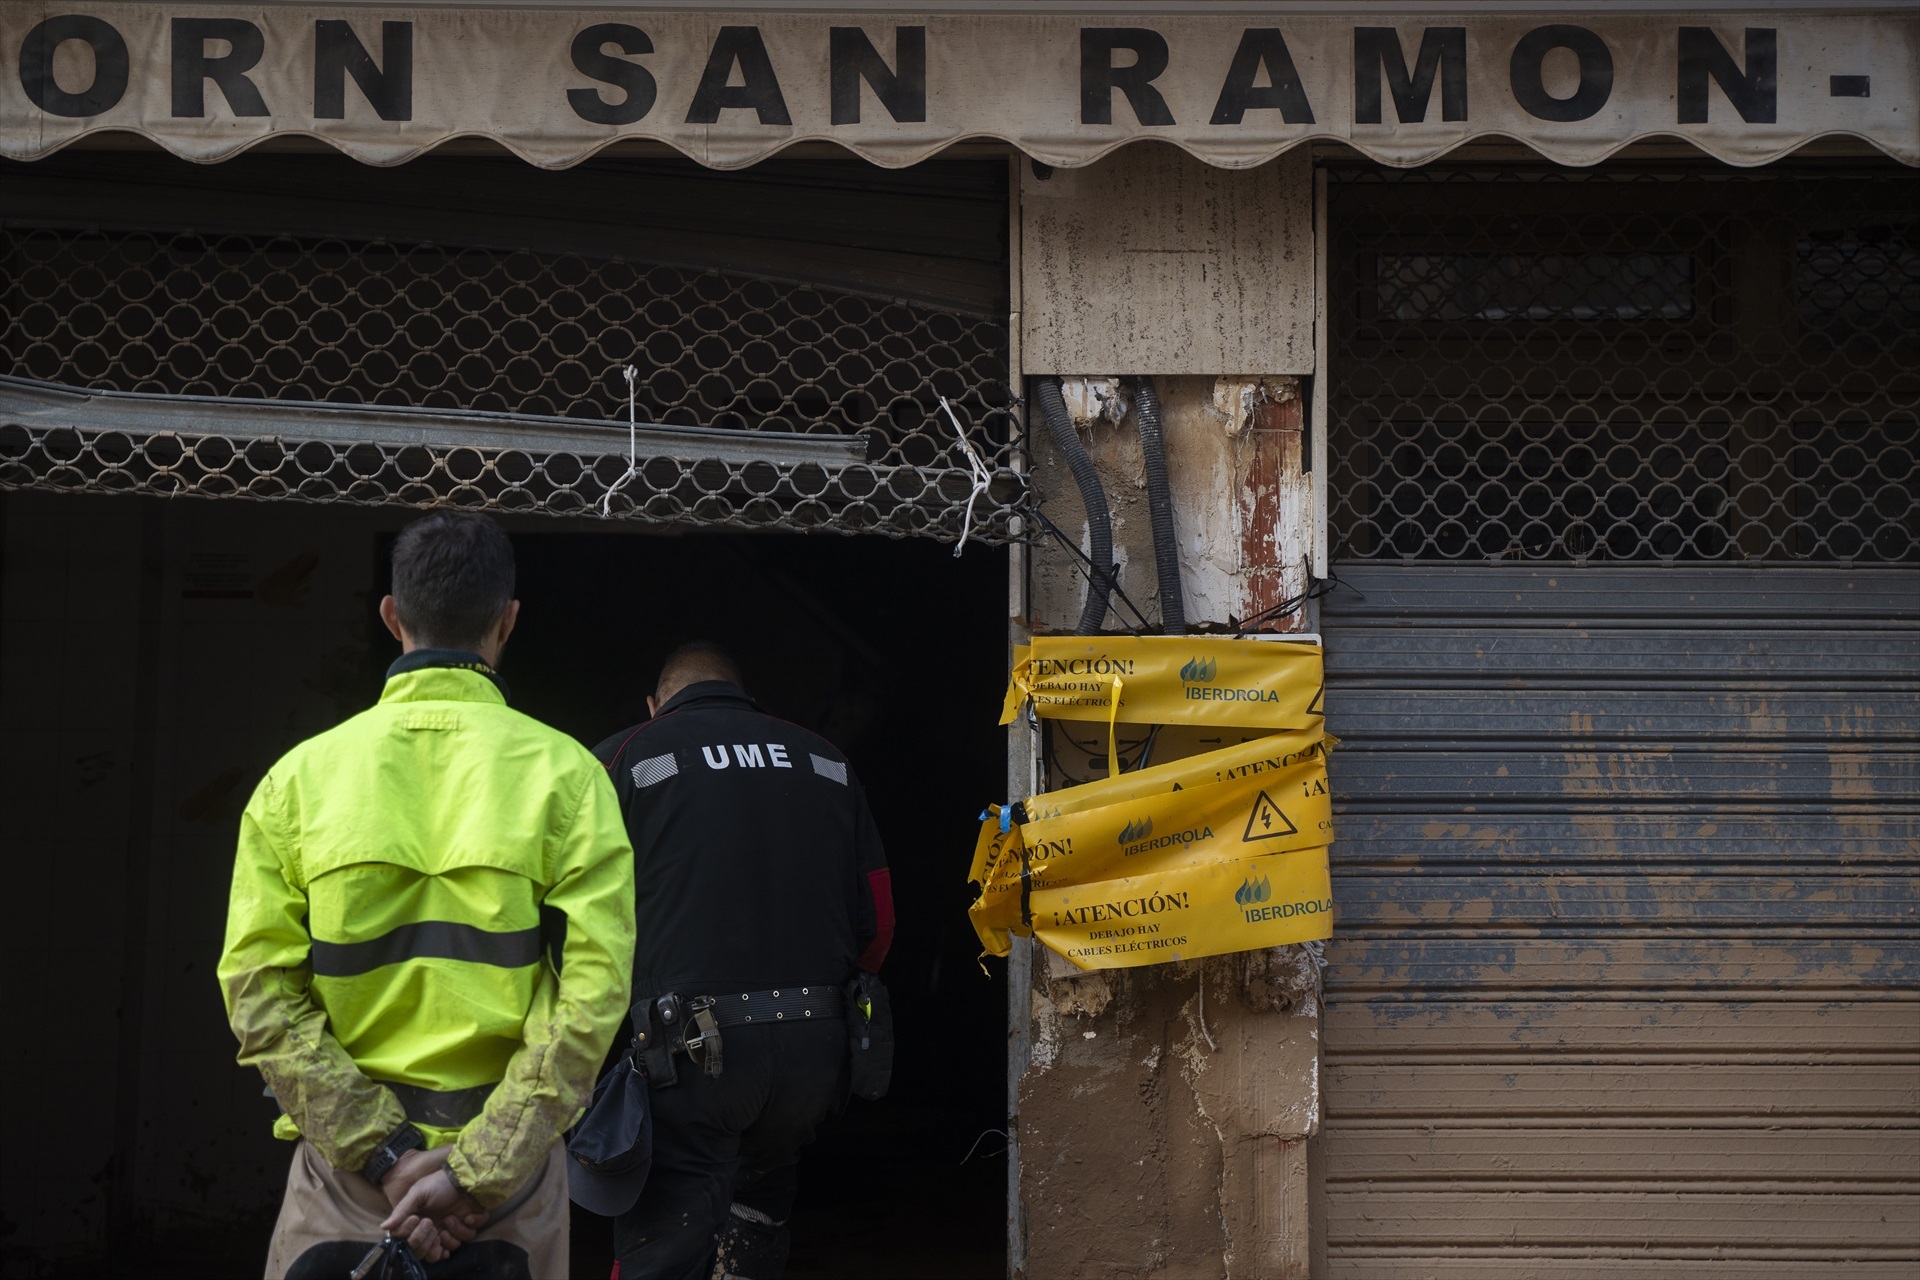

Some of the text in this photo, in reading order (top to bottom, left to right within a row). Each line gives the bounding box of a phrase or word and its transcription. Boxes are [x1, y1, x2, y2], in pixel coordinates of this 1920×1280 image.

[19, 14, 414, 121] ORN
[566, 23, 926, 125] SAN
[1079, 682, 1104, 691] HAY
[1186, 686, 1279, 702] IBERDROLA
[1054, 695, 1125, 707] ELÉCTRICS
[701, 743, 793, 770] UME
[1124, 826, 1214, 857] IBERDROLA
[1053, 891, 1190, 927] ¡ATENCIÓN!
[1245, 898, 1333, 923] IBERDROLA
[1089, 923, 1162, 941] DEBAJO HAY
[1067, 935, 1188, 958] CABLES ELÉCTRICOS
